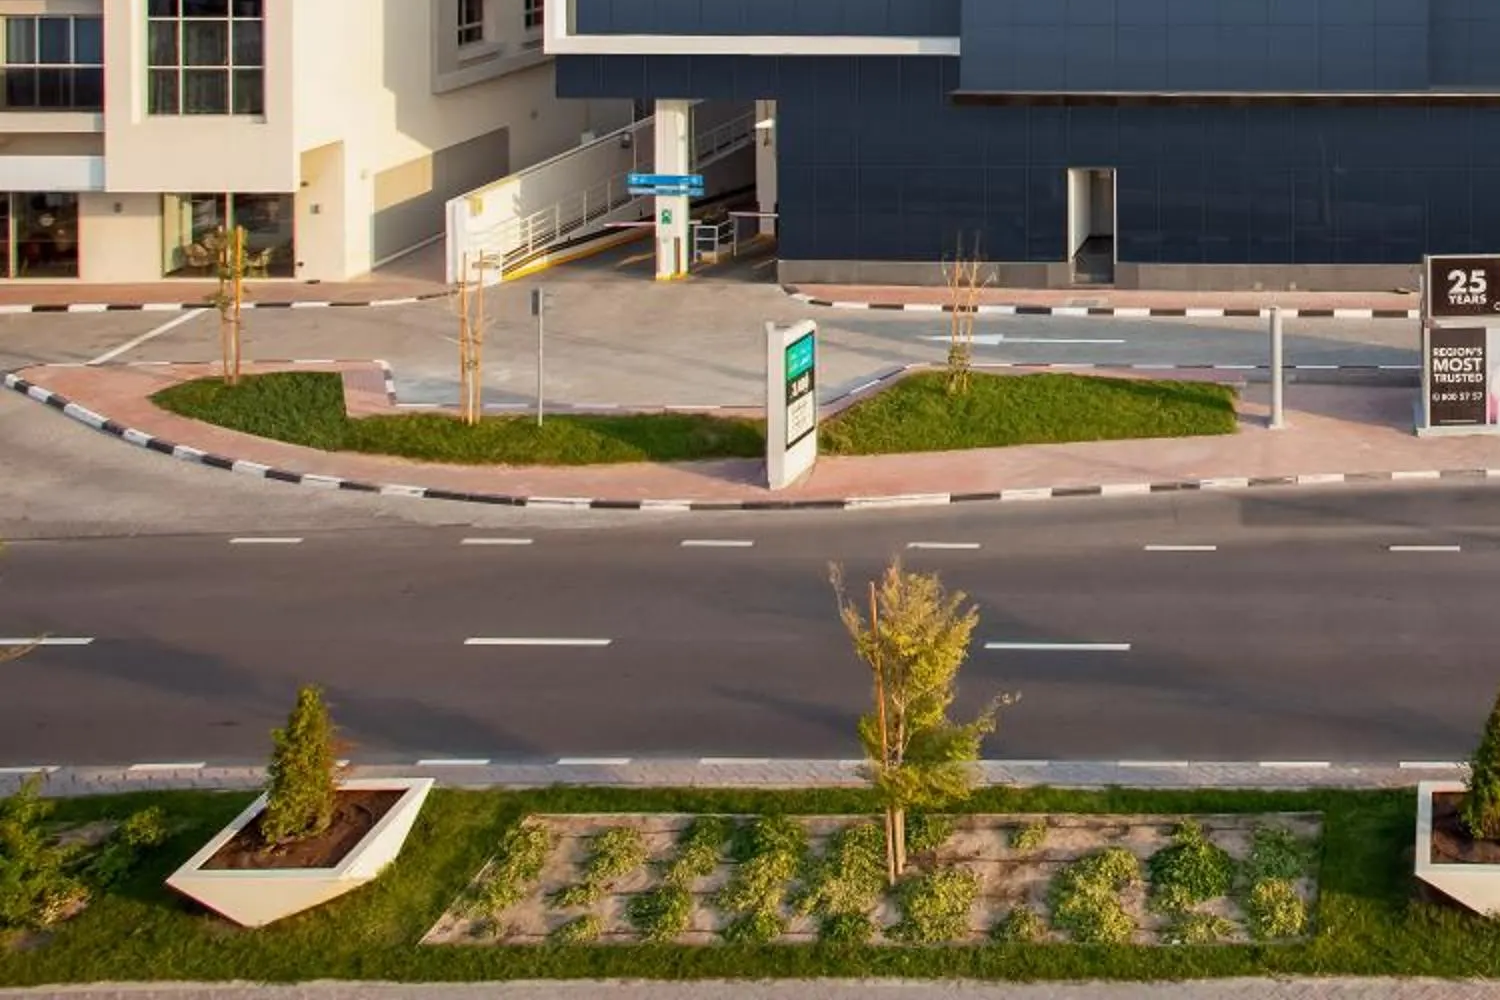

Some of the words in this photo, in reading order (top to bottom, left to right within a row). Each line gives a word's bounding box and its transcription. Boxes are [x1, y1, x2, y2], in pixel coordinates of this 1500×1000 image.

[1447, 269, 1488, 294] 25
[1448, 295, 1488, 305] YEARS
[1433, 357, 1483, 372] MOST
[1433, 373, 1484, 383] TRUSTED
